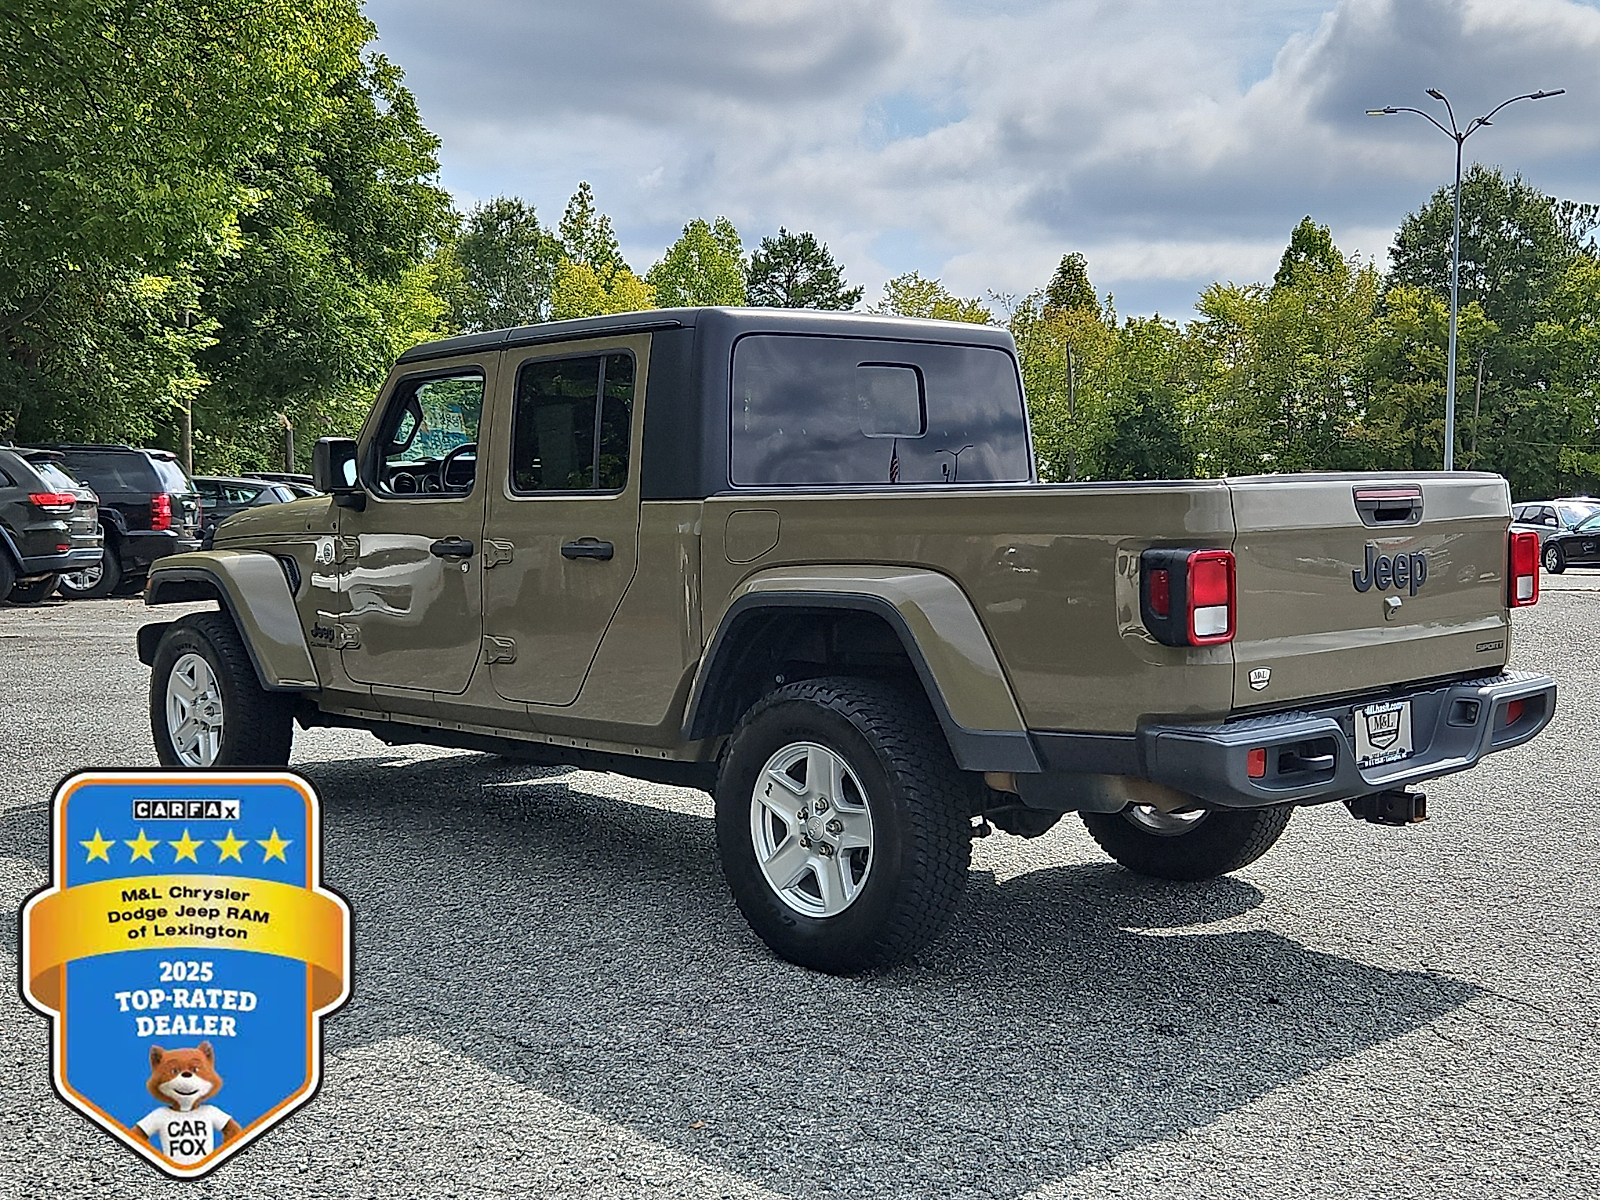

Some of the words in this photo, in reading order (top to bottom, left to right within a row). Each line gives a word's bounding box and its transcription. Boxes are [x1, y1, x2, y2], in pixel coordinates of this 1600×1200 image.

[1352, 543, 1427, 597] Jeep
[1476, 641, 1503, 651] SPORT
[1373, 713, 1396, 731] M&L
